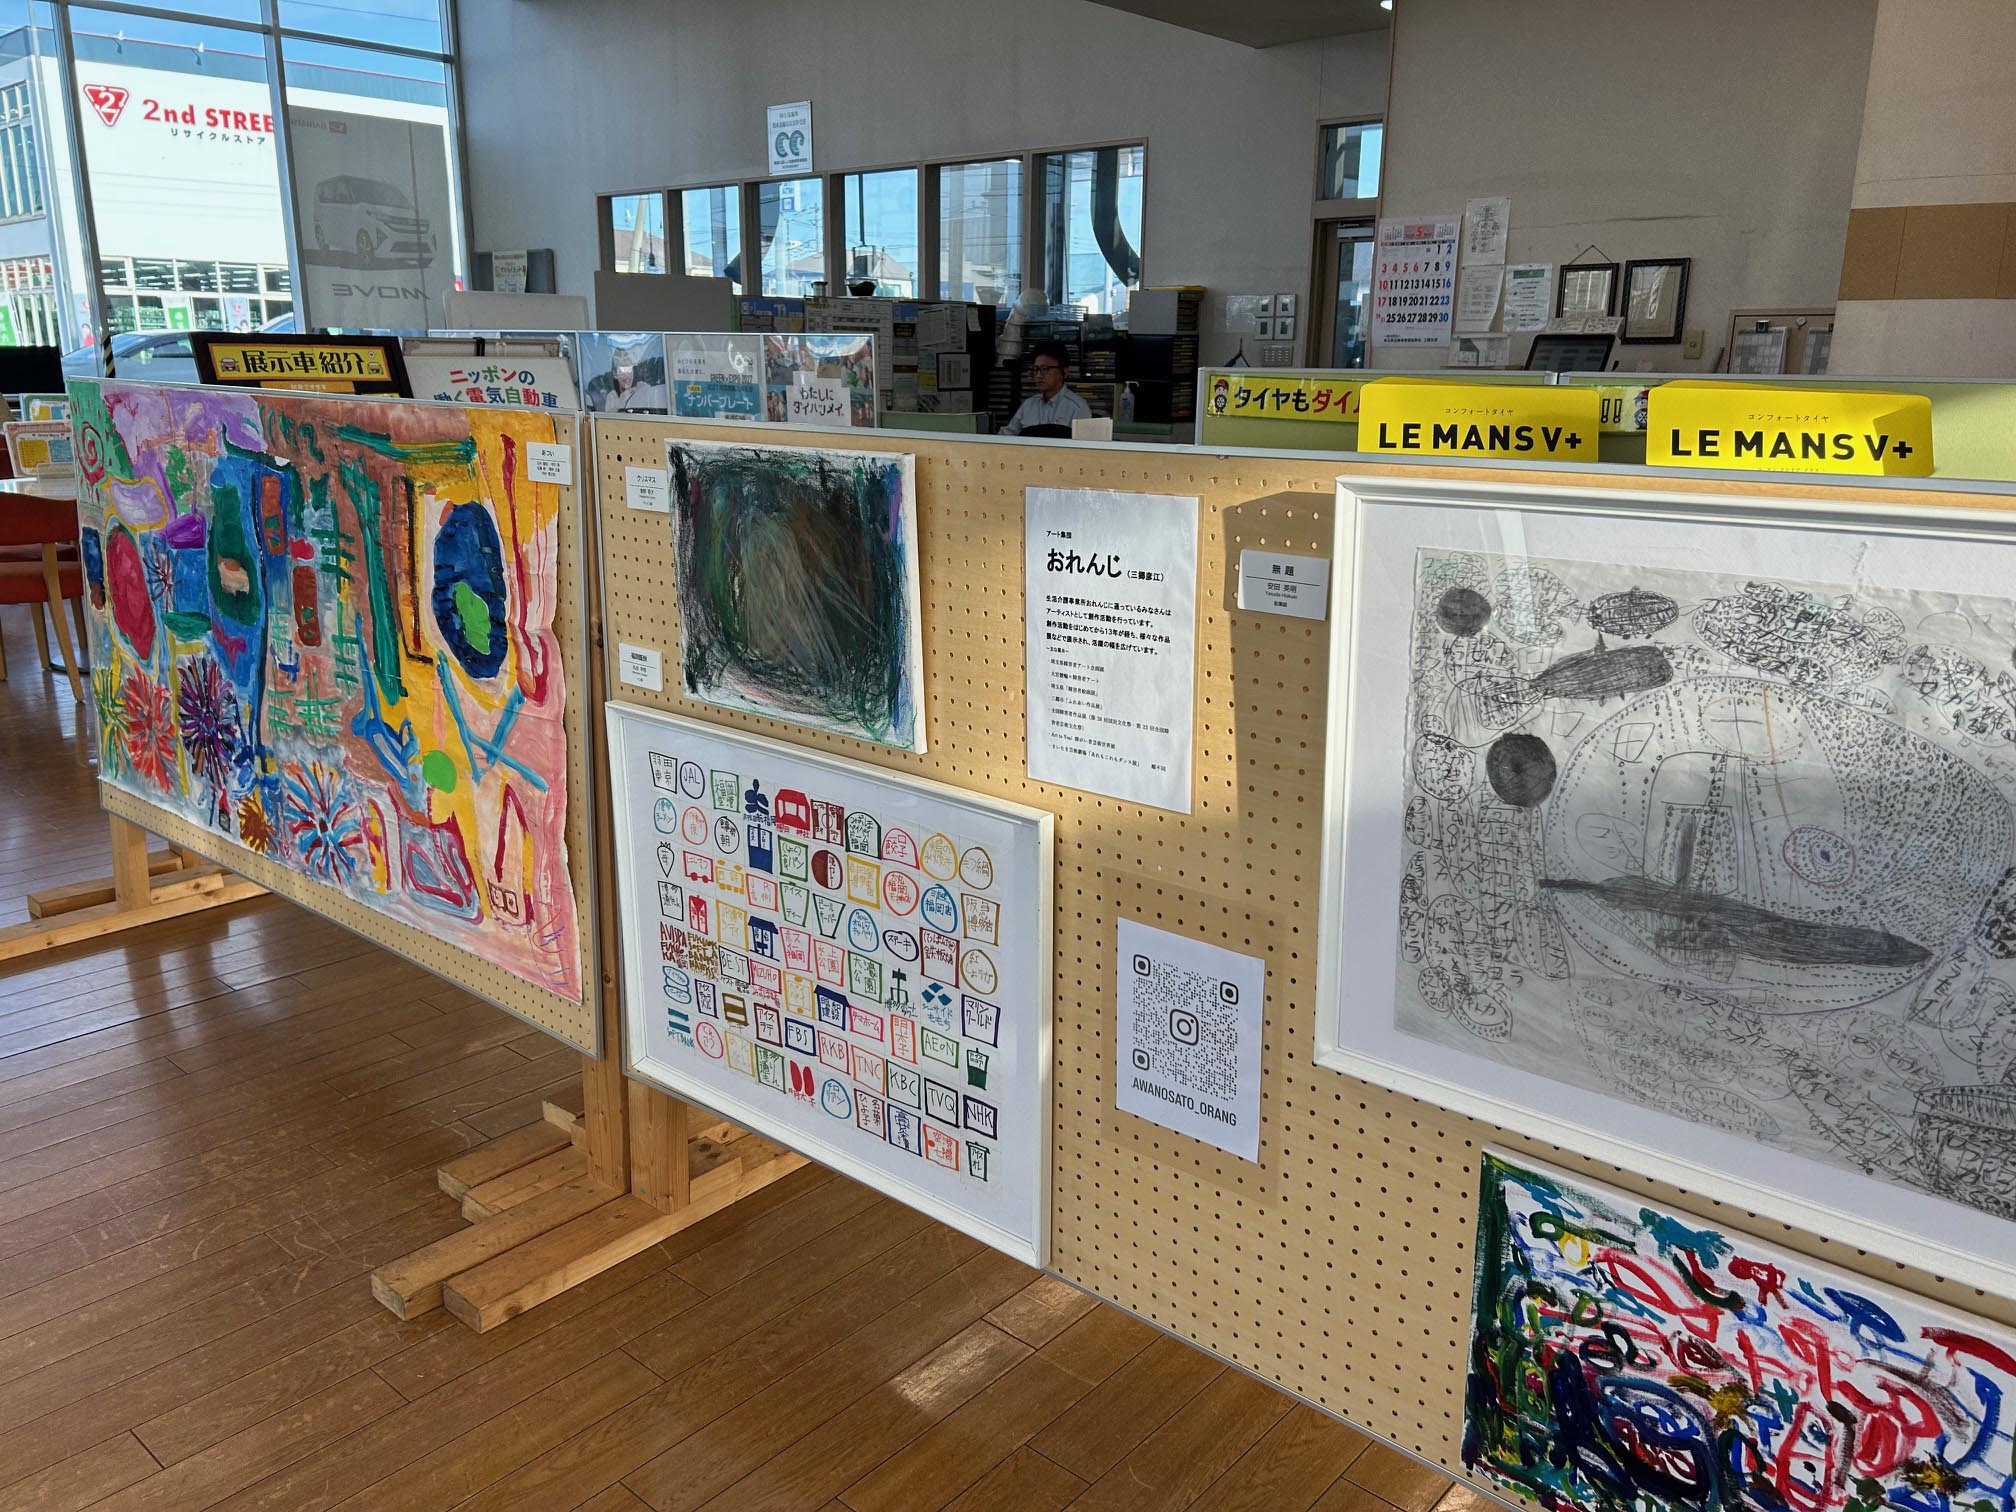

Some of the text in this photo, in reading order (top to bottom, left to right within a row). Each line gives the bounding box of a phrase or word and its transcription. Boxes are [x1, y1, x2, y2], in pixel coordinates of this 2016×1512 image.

[142, 99, 196, 126] 2nd
[170, 128, 266, 145] リサイクルストア
[1415, 226, 1424, 237] 5
[1437, 244, 1453, 255] 1 2
[1381, 261, 1451, 273] 3 4 5 6 7 8 9
[1379, 279, 1451, 290] 10 11 12 13 14 15 16
[1378, 295, 1450, 307] 17 18 19 20 21 22 23
[1386, 313, 1396, 323] 25
[1397, 313, 1406, 323] 26
[1407, 313, 1416, 323] 27
[1417, 313, 1427, 323] 28
[1428, 313, 1438, 322] 29
[1438, 312, 1449, 322] 30
[243, 350, 364, 374] 展示車紹介
[450, 366, 535, 386] ニッポンの
[687, 394, 754, 409] ナンバープレート
[800, 387, 834, 401] わたしに
[1444, 406, 1515, 416] コンフォートタイヤ
[1747, 412, 1831, 424] コンフォートタイヤ
[1378, 422, 1583, 453] LE MANS V+
[1671, 429, 1913, 462] LE MANS V+
[1046, 530, 1072, 540] アート集団
[1046, 547, 1122, 579] おれんじ
[1045, 594, 1172, 617] 生活介護事業所おれんじに通っているみなさんは
[1045, 607, 1154, 629] アーティストとして創作活動を行っています。
[1045, 620, 1171, 644] 創作活動をはじめてから13年が経ち、様々な作品
[683, 767, 700, 785] JAL
[887, 934, 912, 952] ステーキ
[720, 950, 746, 976] BEST
[757, 1007, 775, 1023] アイス
[965, 999, 990, 1014] マリン
[965, 1010, 992, 1031] ワールド
[788, 1025, 808, 1046] FBS
[820, 1037, 846, 1061] RKB
[855, 1055, 882, 1081] TNC
[889, 1068, 917, 1097] KBC
[928, 1087, 956, 1115] TVQ
[965, 1102, 994, 1129] NHK
